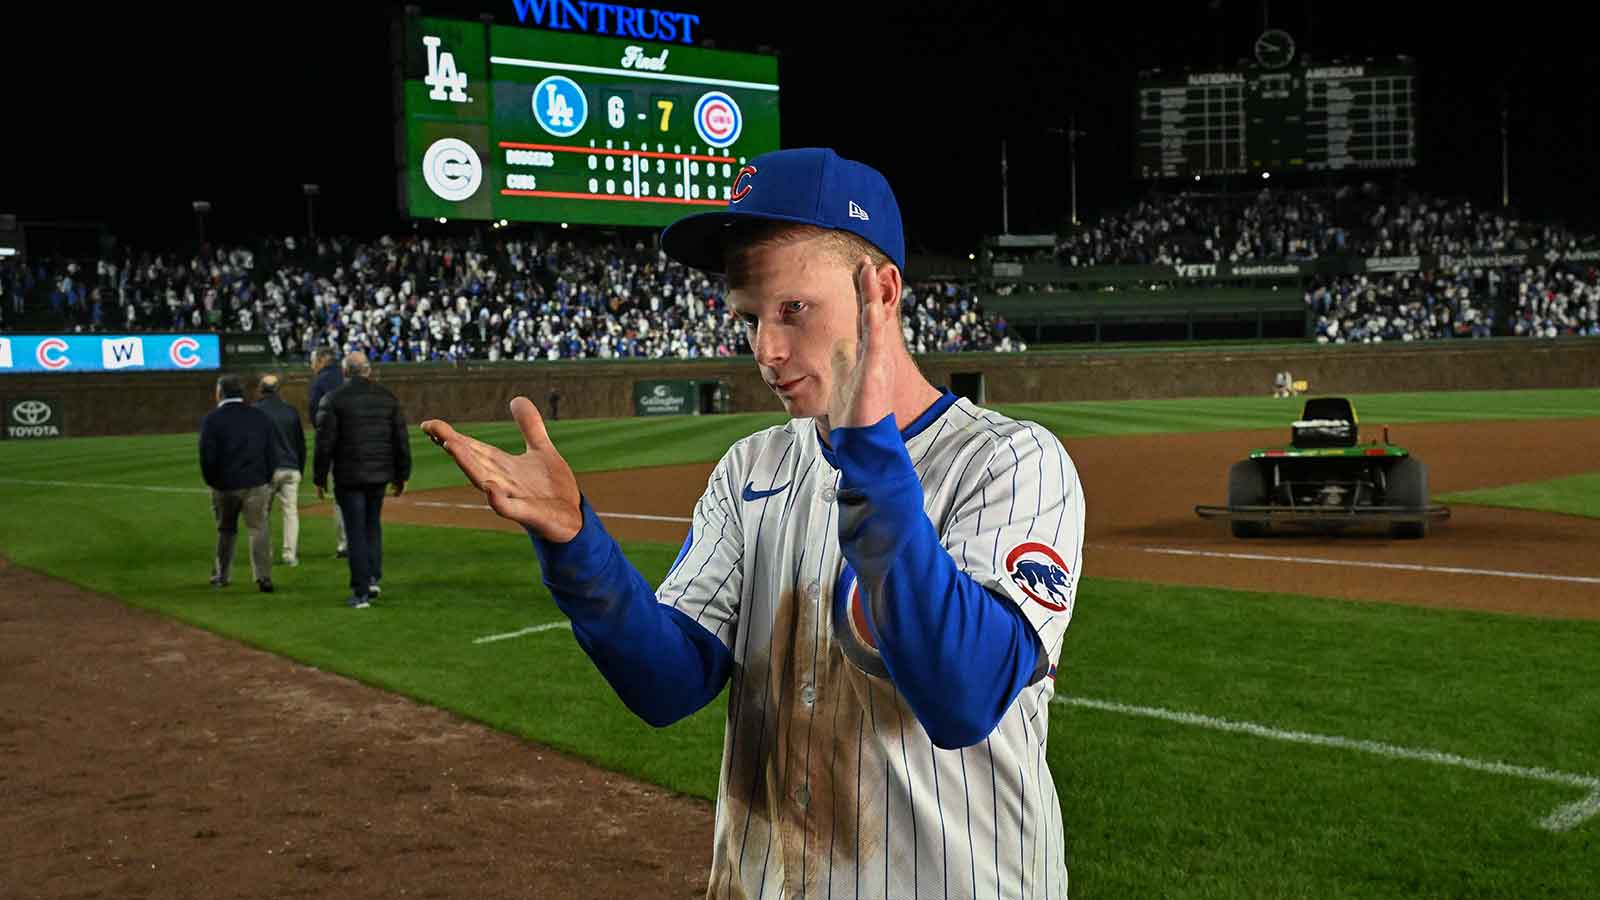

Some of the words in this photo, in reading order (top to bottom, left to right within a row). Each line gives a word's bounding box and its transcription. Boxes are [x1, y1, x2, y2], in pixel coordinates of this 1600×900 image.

[512, 0, 700, 45] WINTRUST
[423, 36, 468, 102] LA
[621, 45, 669, 71] Final
[1188, 72, 1245, 84] NATIONAL
[1305, 67, 1364, 79] AMERICAN
[545, 84, 574, 127] LA
[607, 96, 625, 129] 6
[657, 100, 674, 132] 7
[656, 182, 667, 197] 4
[731, 166, 757, 203] C
[1174, 264, 1217, 278] YETI
[1440, 253, 1527, 270] Budweiser
[37, 338, 69, 369] C
[112, 343, 134, 363] W
[170, 337, 201, 369] C
[8, 425, 59, 438] TOYOTA
